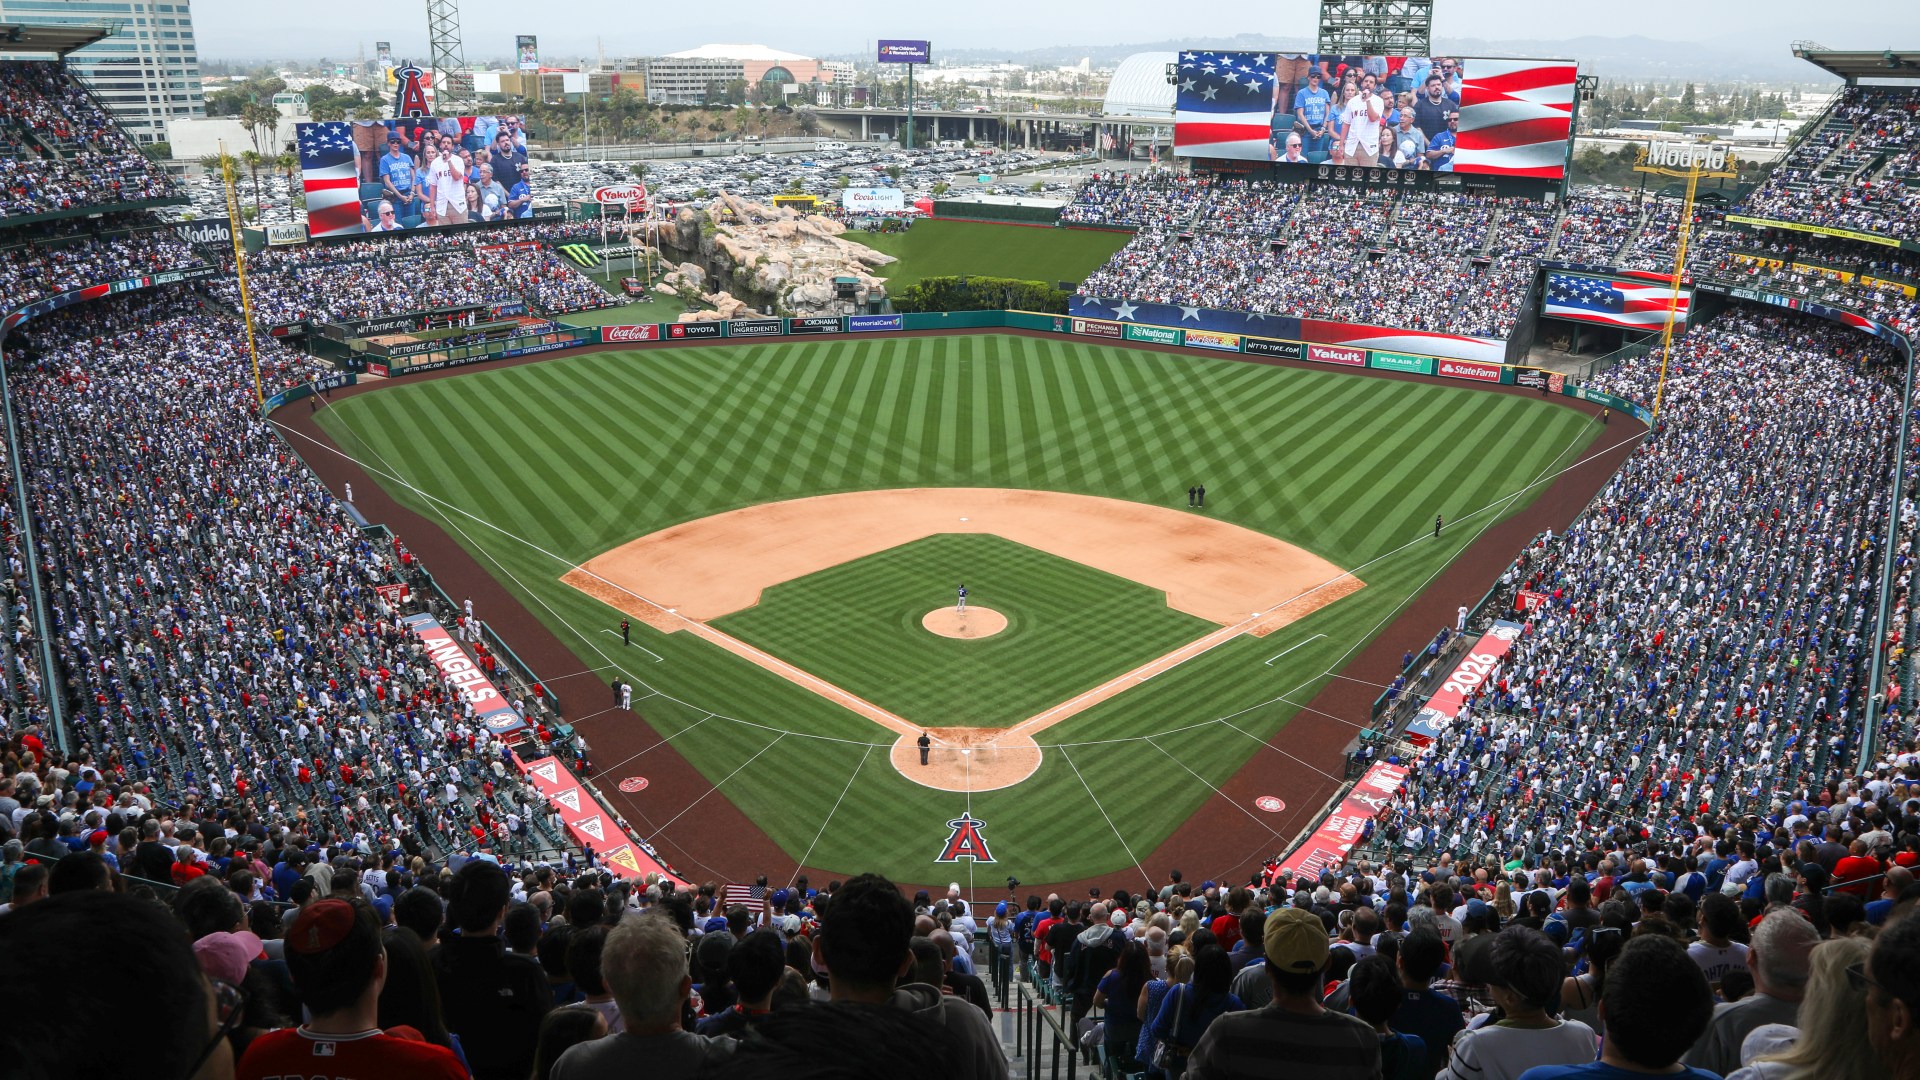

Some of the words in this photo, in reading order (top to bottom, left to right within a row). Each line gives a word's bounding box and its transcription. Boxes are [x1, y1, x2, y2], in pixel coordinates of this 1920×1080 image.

[1647, 140, 1725, 169] Modelo
[1320, 167, 1327, 175] 11
[1353, 169, 1362, 177] 29
[1371, 170, 1380, 178] 30
[1406, 172, 1415, 180] 50
[604, 190, 639, 200] Yakult
[854, 192, 873, 201] Coors
[177, 224, 230, 243] Modelo
[273, 227, 301, 240] Modelo
[610, 326, 649, 340] Coca-Cola
[1142, 328, 1175, 339] National
[1188, 333, 1219, 345] Surfside
[522, 343, 563, 353] 714TICKETS.COM
[1269, 345, 1299, 354] TIRE.COM
[450, 358, 465, 366] NITTO
[466, 354, 488, 362] TIRE.COM
[1312, 348, 1362, 362] Yakult
[421, 362, 445, 371] TIRE.COM
[424, 638, 497, 702] ANGELS
[1444, 653, 1497, 695] 2026
[934, 812, 998, 862] A
[366, 874, 379, 882] BETTS
